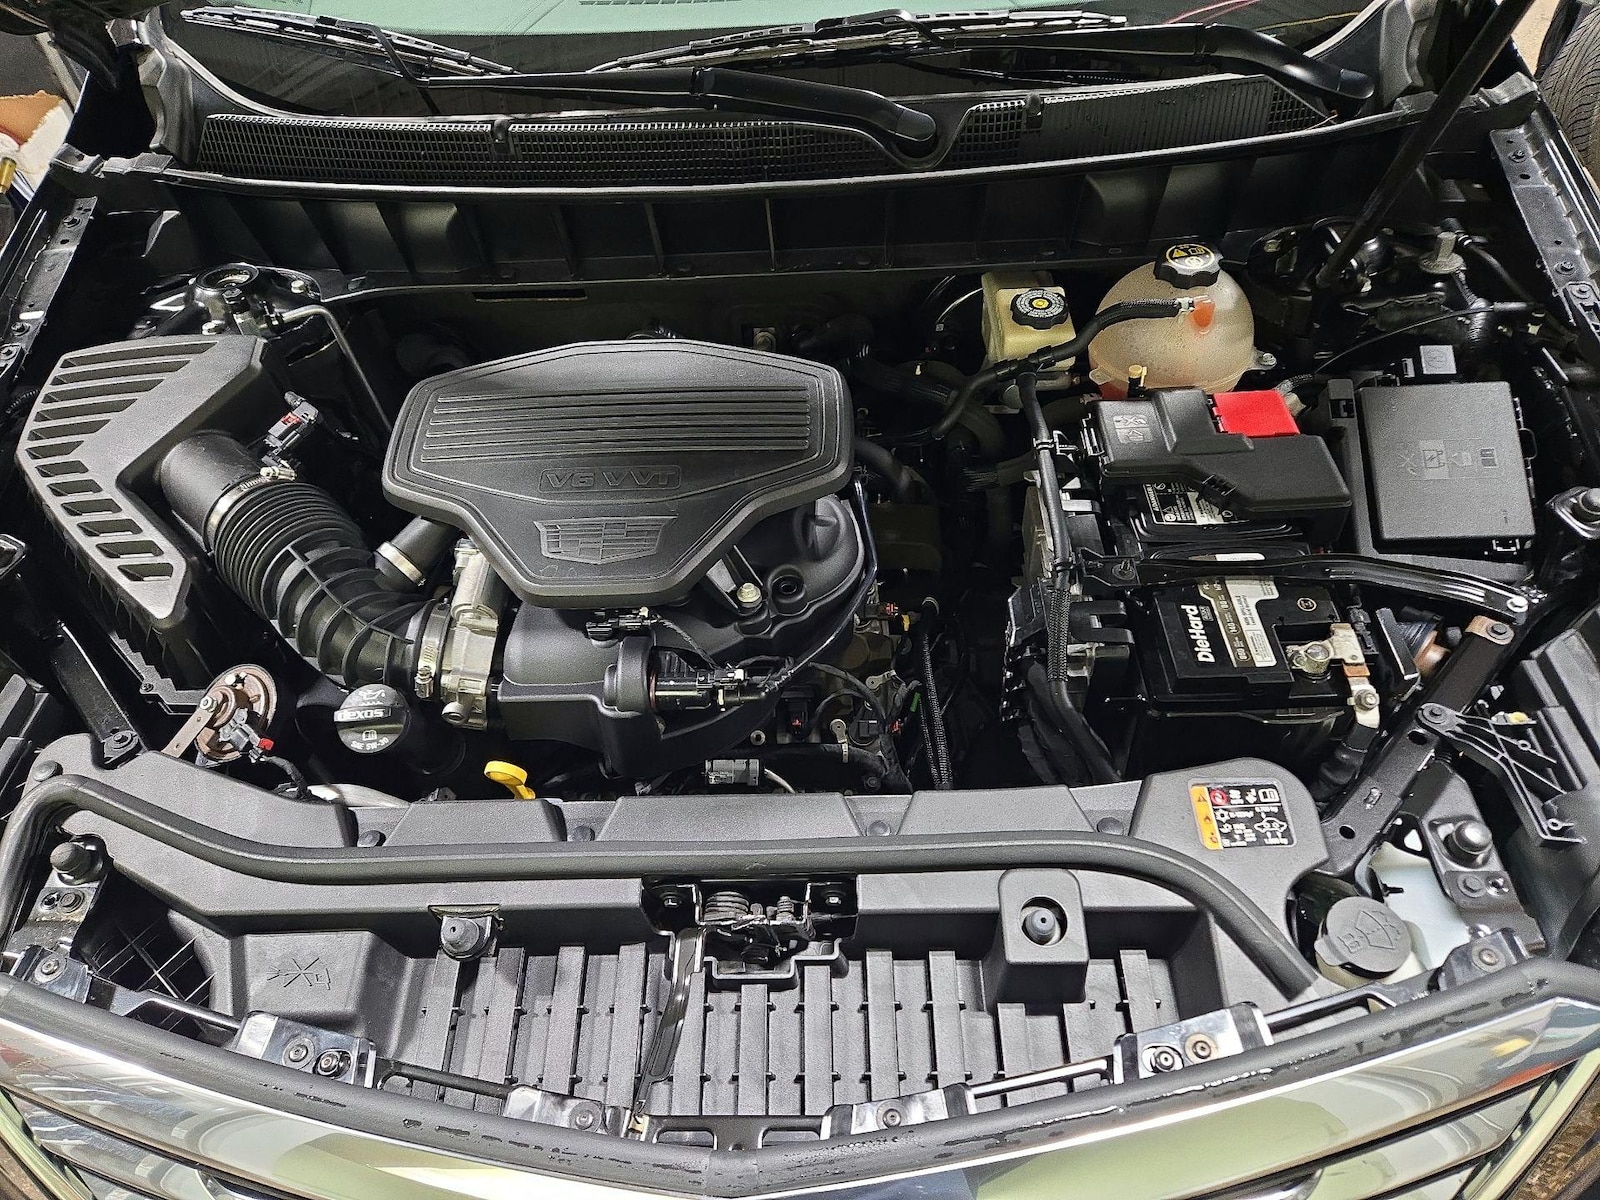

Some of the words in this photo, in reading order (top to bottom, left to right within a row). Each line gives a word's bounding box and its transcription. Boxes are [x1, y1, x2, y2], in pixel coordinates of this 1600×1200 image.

[545, 471, 595, 488] V6
[602, 469, 676, 486] VVT
[1180, 604, 1216, 663] DieHard
[337, 707, 386, 721] dexos
[366, 736, 389, 750] 5W-30
